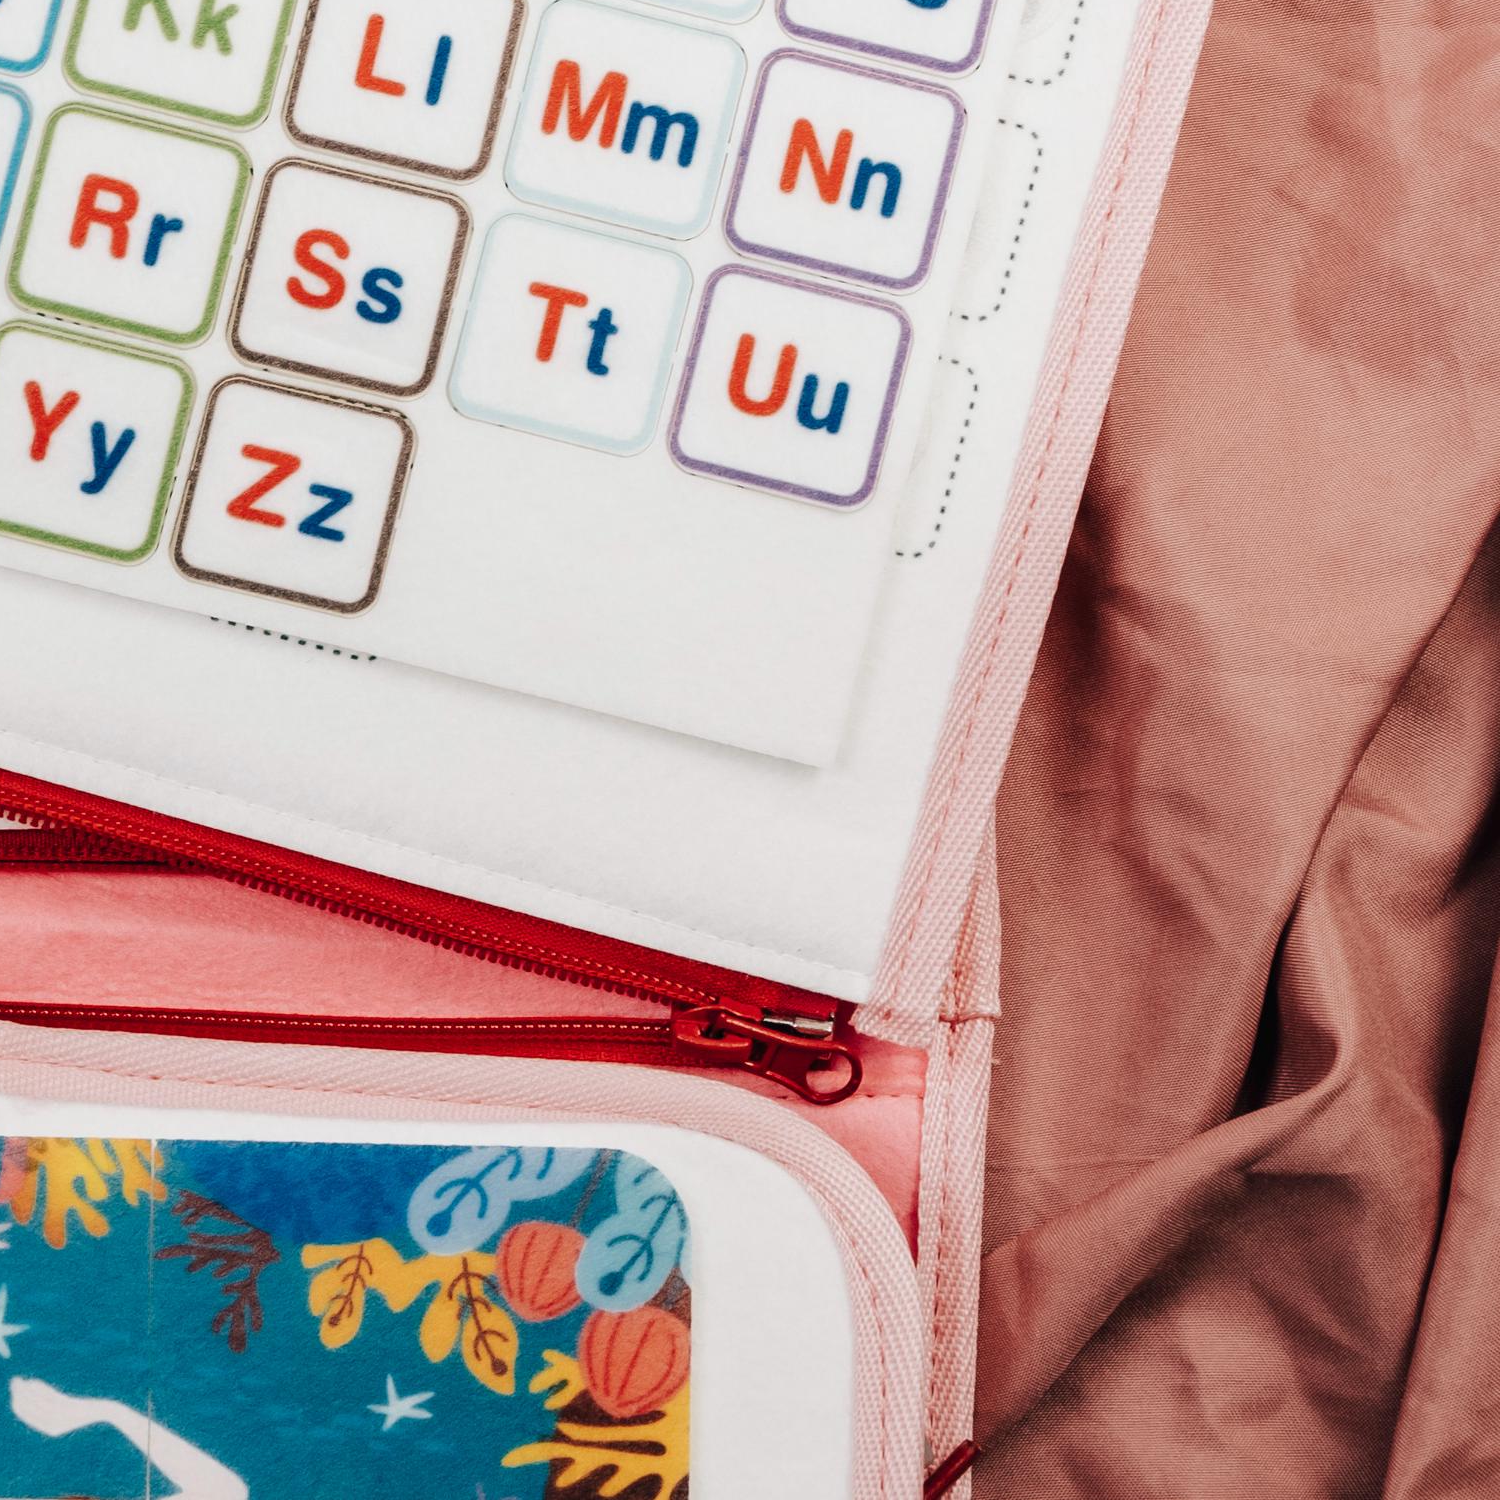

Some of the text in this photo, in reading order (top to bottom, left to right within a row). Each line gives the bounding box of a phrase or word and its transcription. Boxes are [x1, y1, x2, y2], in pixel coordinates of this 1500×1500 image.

[355, 14, 452, 105] Ll
[541, 60, 699, 168] Mm
[780, 118, 901, 218] Nn
[69, 174, 183, 266] Rr
[286, 229, 403, 324] Ss
[529, 282, 618, 376] Tt
[728, 333, 849, 434] Uu
[24, 381, 136, 494] Yy
[227, 444, 353, 542] Zz
